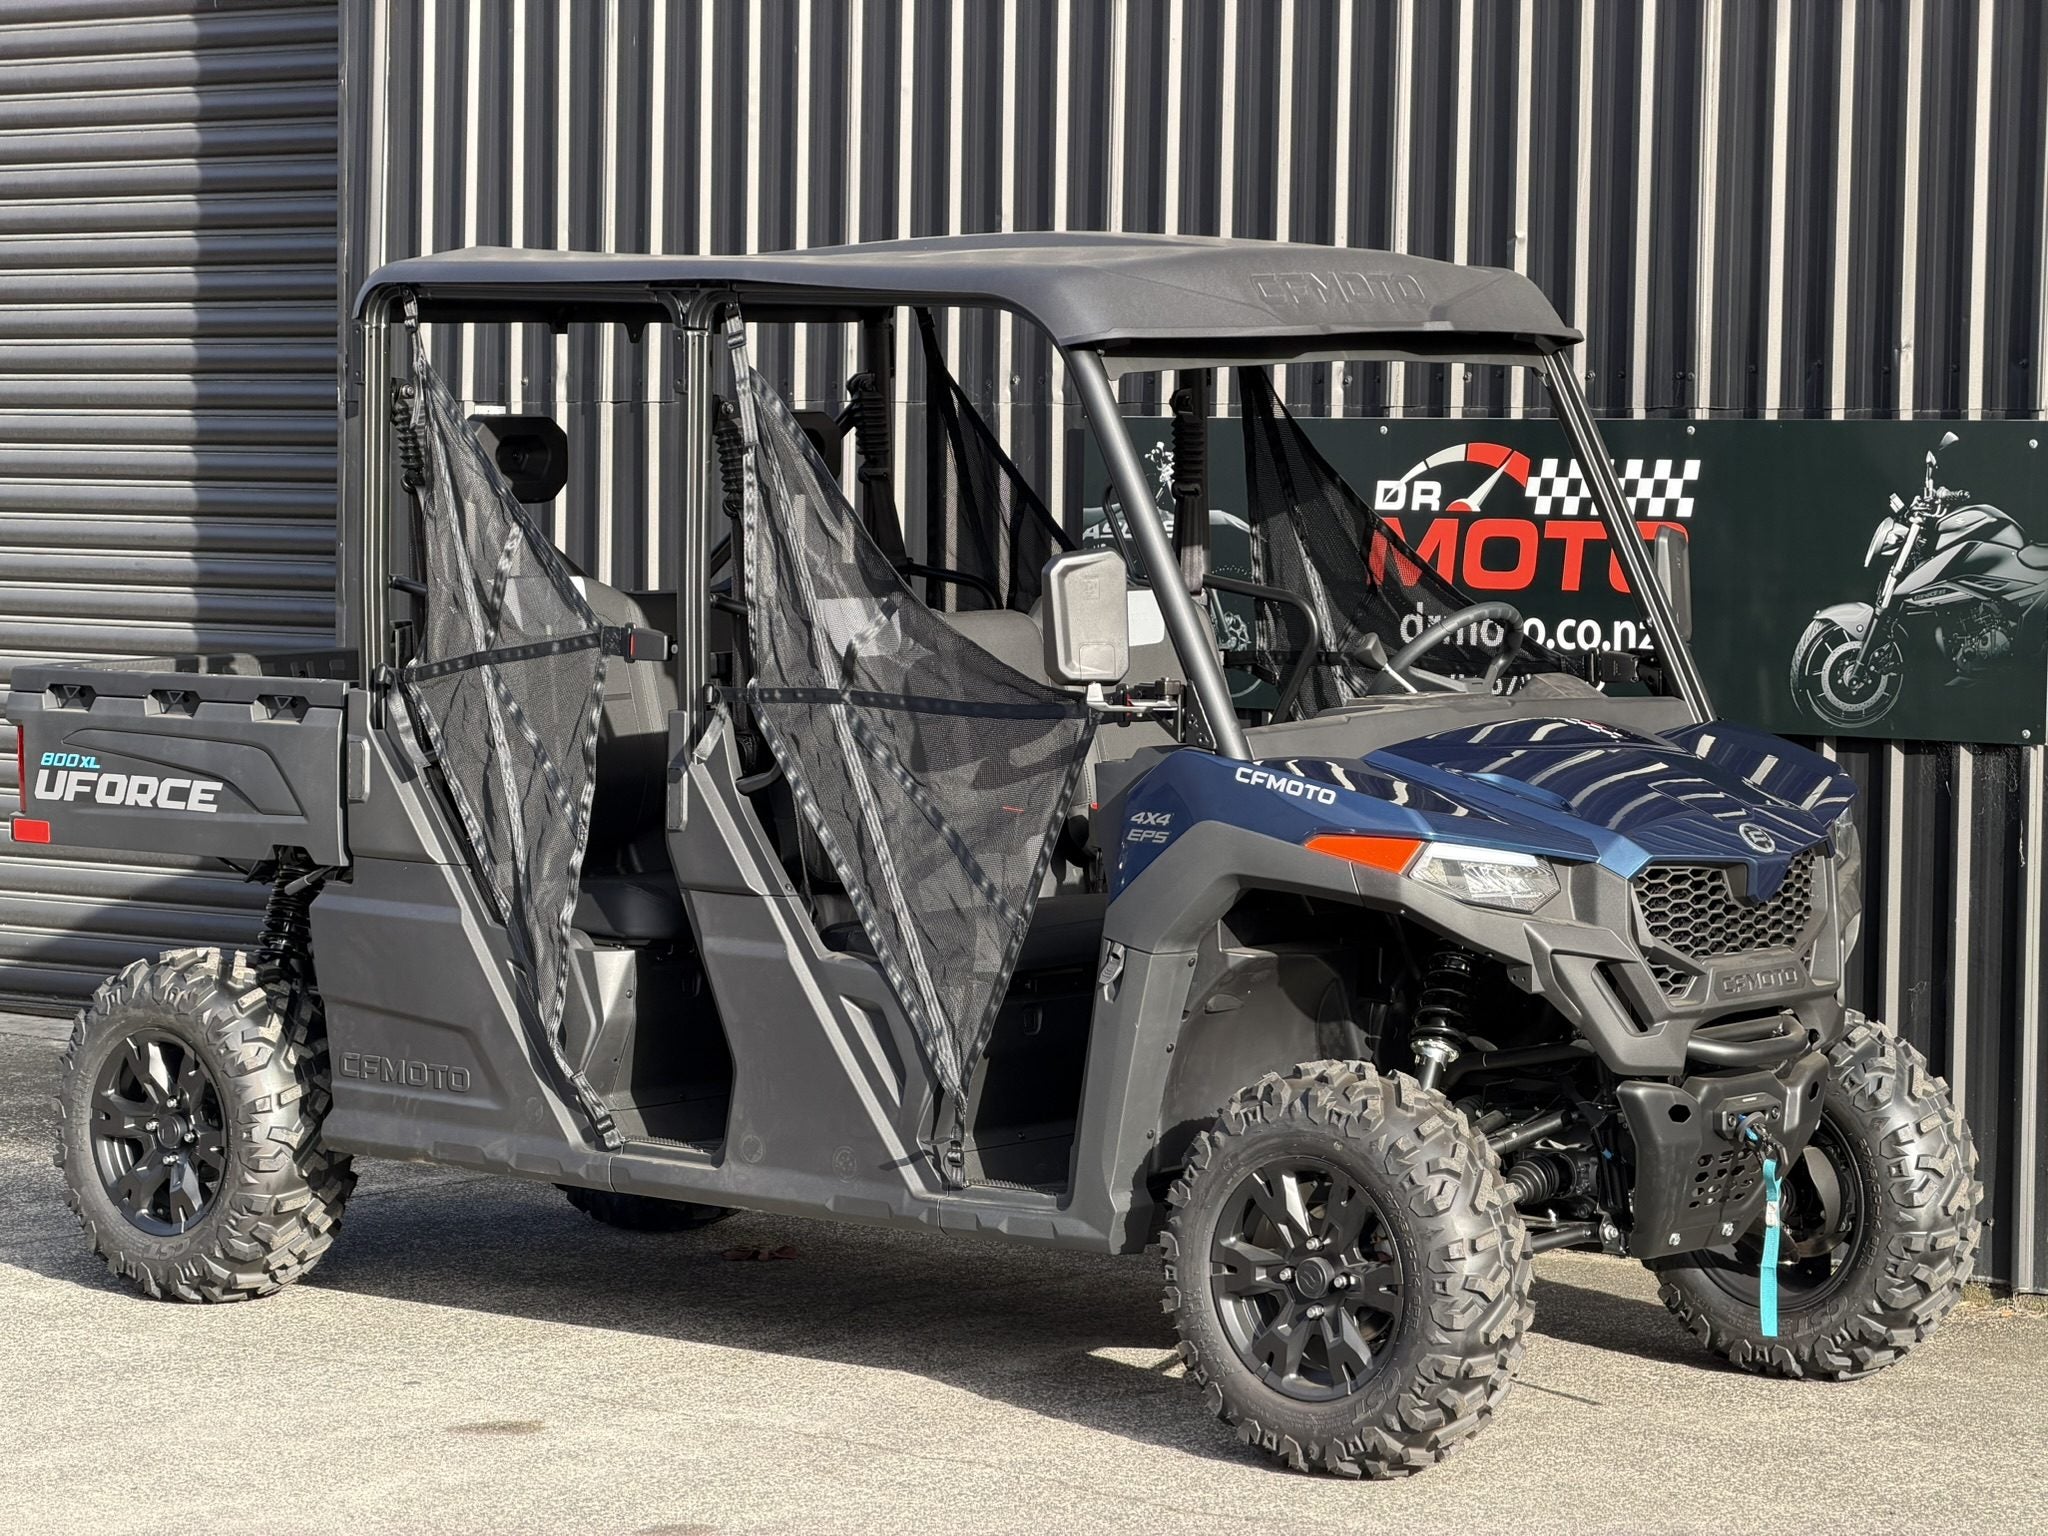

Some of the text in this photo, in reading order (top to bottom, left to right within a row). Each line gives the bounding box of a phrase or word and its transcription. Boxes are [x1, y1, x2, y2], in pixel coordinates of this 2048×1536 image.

[1251, 270, 1428, 306] CFMOTO
[1374, 480, 1442, 511] DR
[1400, 601, 1656, 651] dmoo.co.nz
[34, 769, 224, 813] UFORCE
[1235, 767, 1337, 805] CFMOTO
[1127, 829, 1170, 843] EPS
[1130, 811, 1172, 826] 4X4
[1722, 967, 1798, 993] CFMOTO
[339, 1052, 470, 1092] CFMOTO
